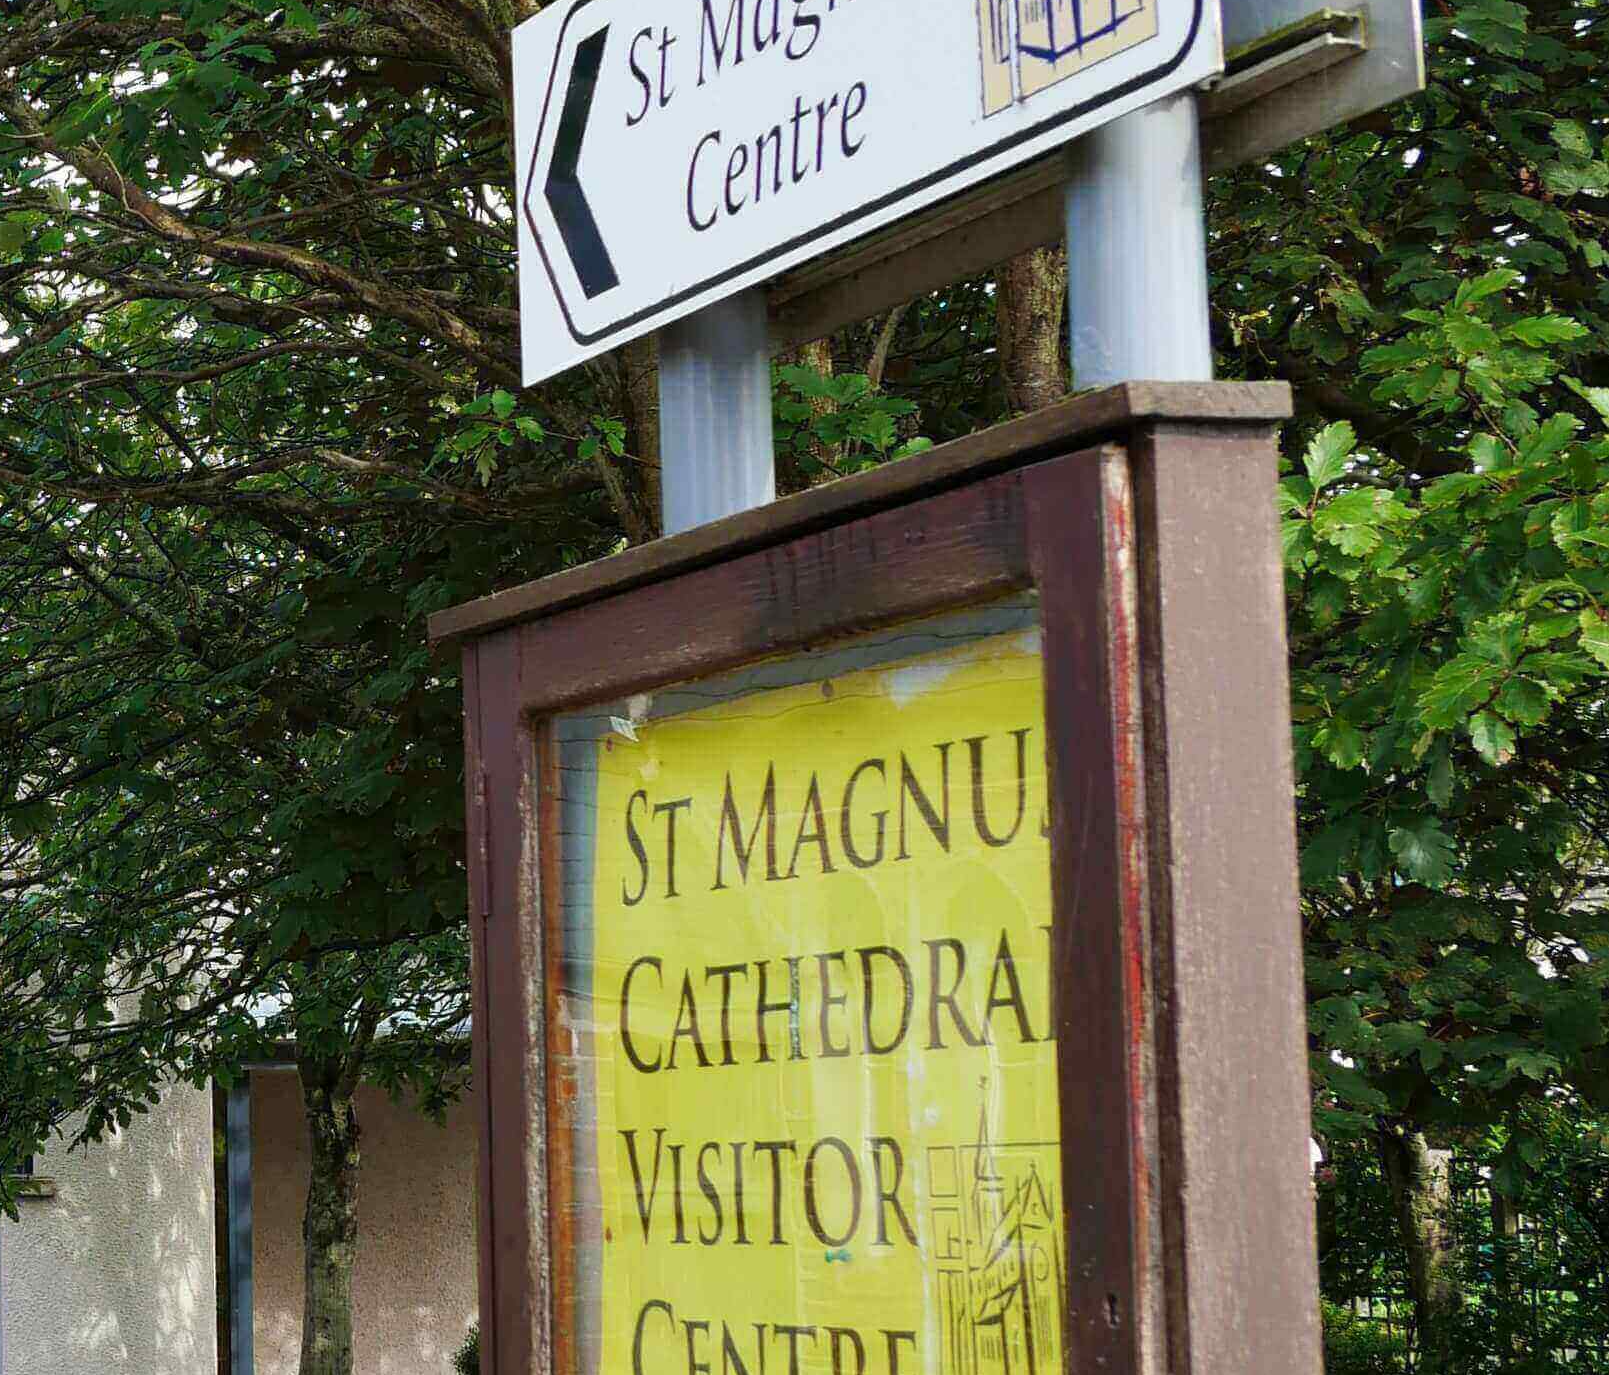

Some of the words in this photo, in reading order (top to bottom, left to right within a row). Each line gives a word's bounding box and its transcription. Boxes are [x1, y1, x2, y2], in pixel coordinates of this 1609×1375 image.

[625, 25, 677, 126] St
[686, 81, 867, 233] Centre
[710, 727, 1050, 890] MAGNU
[619, 1128, 919, 1248] VISITOR
